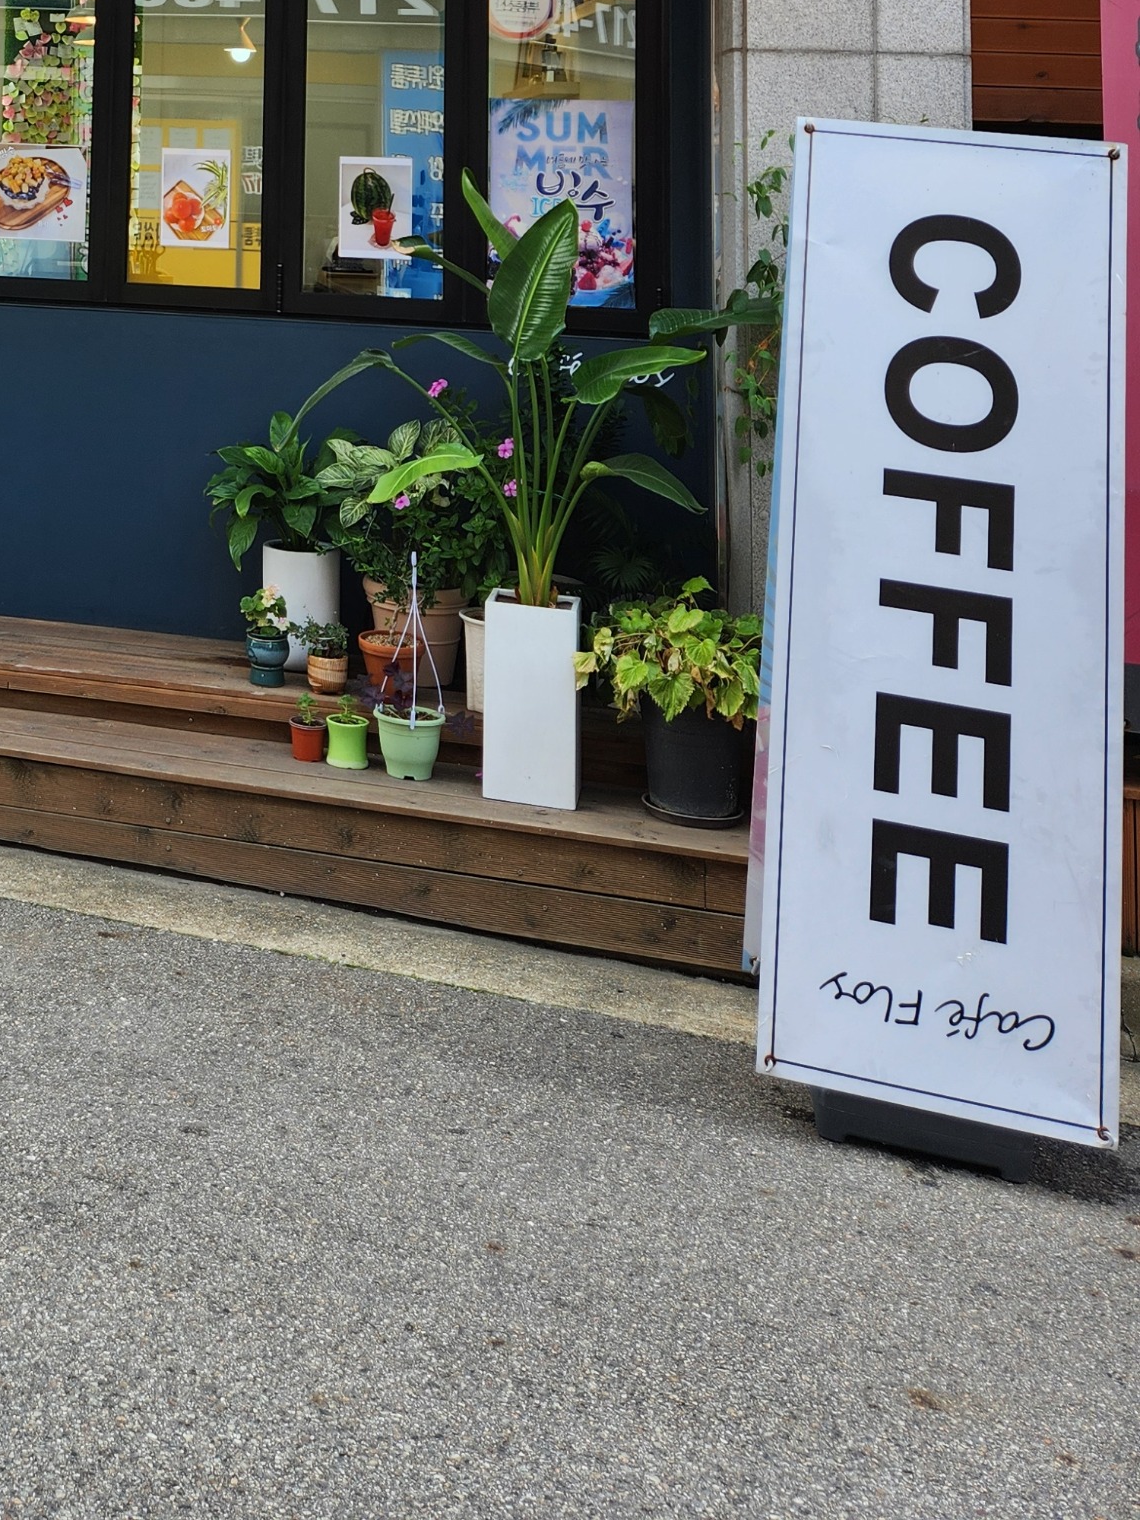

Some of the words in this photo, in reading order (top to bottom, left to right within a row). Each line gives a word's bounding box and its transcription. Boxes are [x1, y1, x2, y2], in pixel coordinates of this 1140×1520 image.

[516, 111, 608, 144] SUM
[870, 214, 1022, 945] COFFEE
[819, 972, 922, 1027] Flos
[935, 993, 1056, 1052] Café
